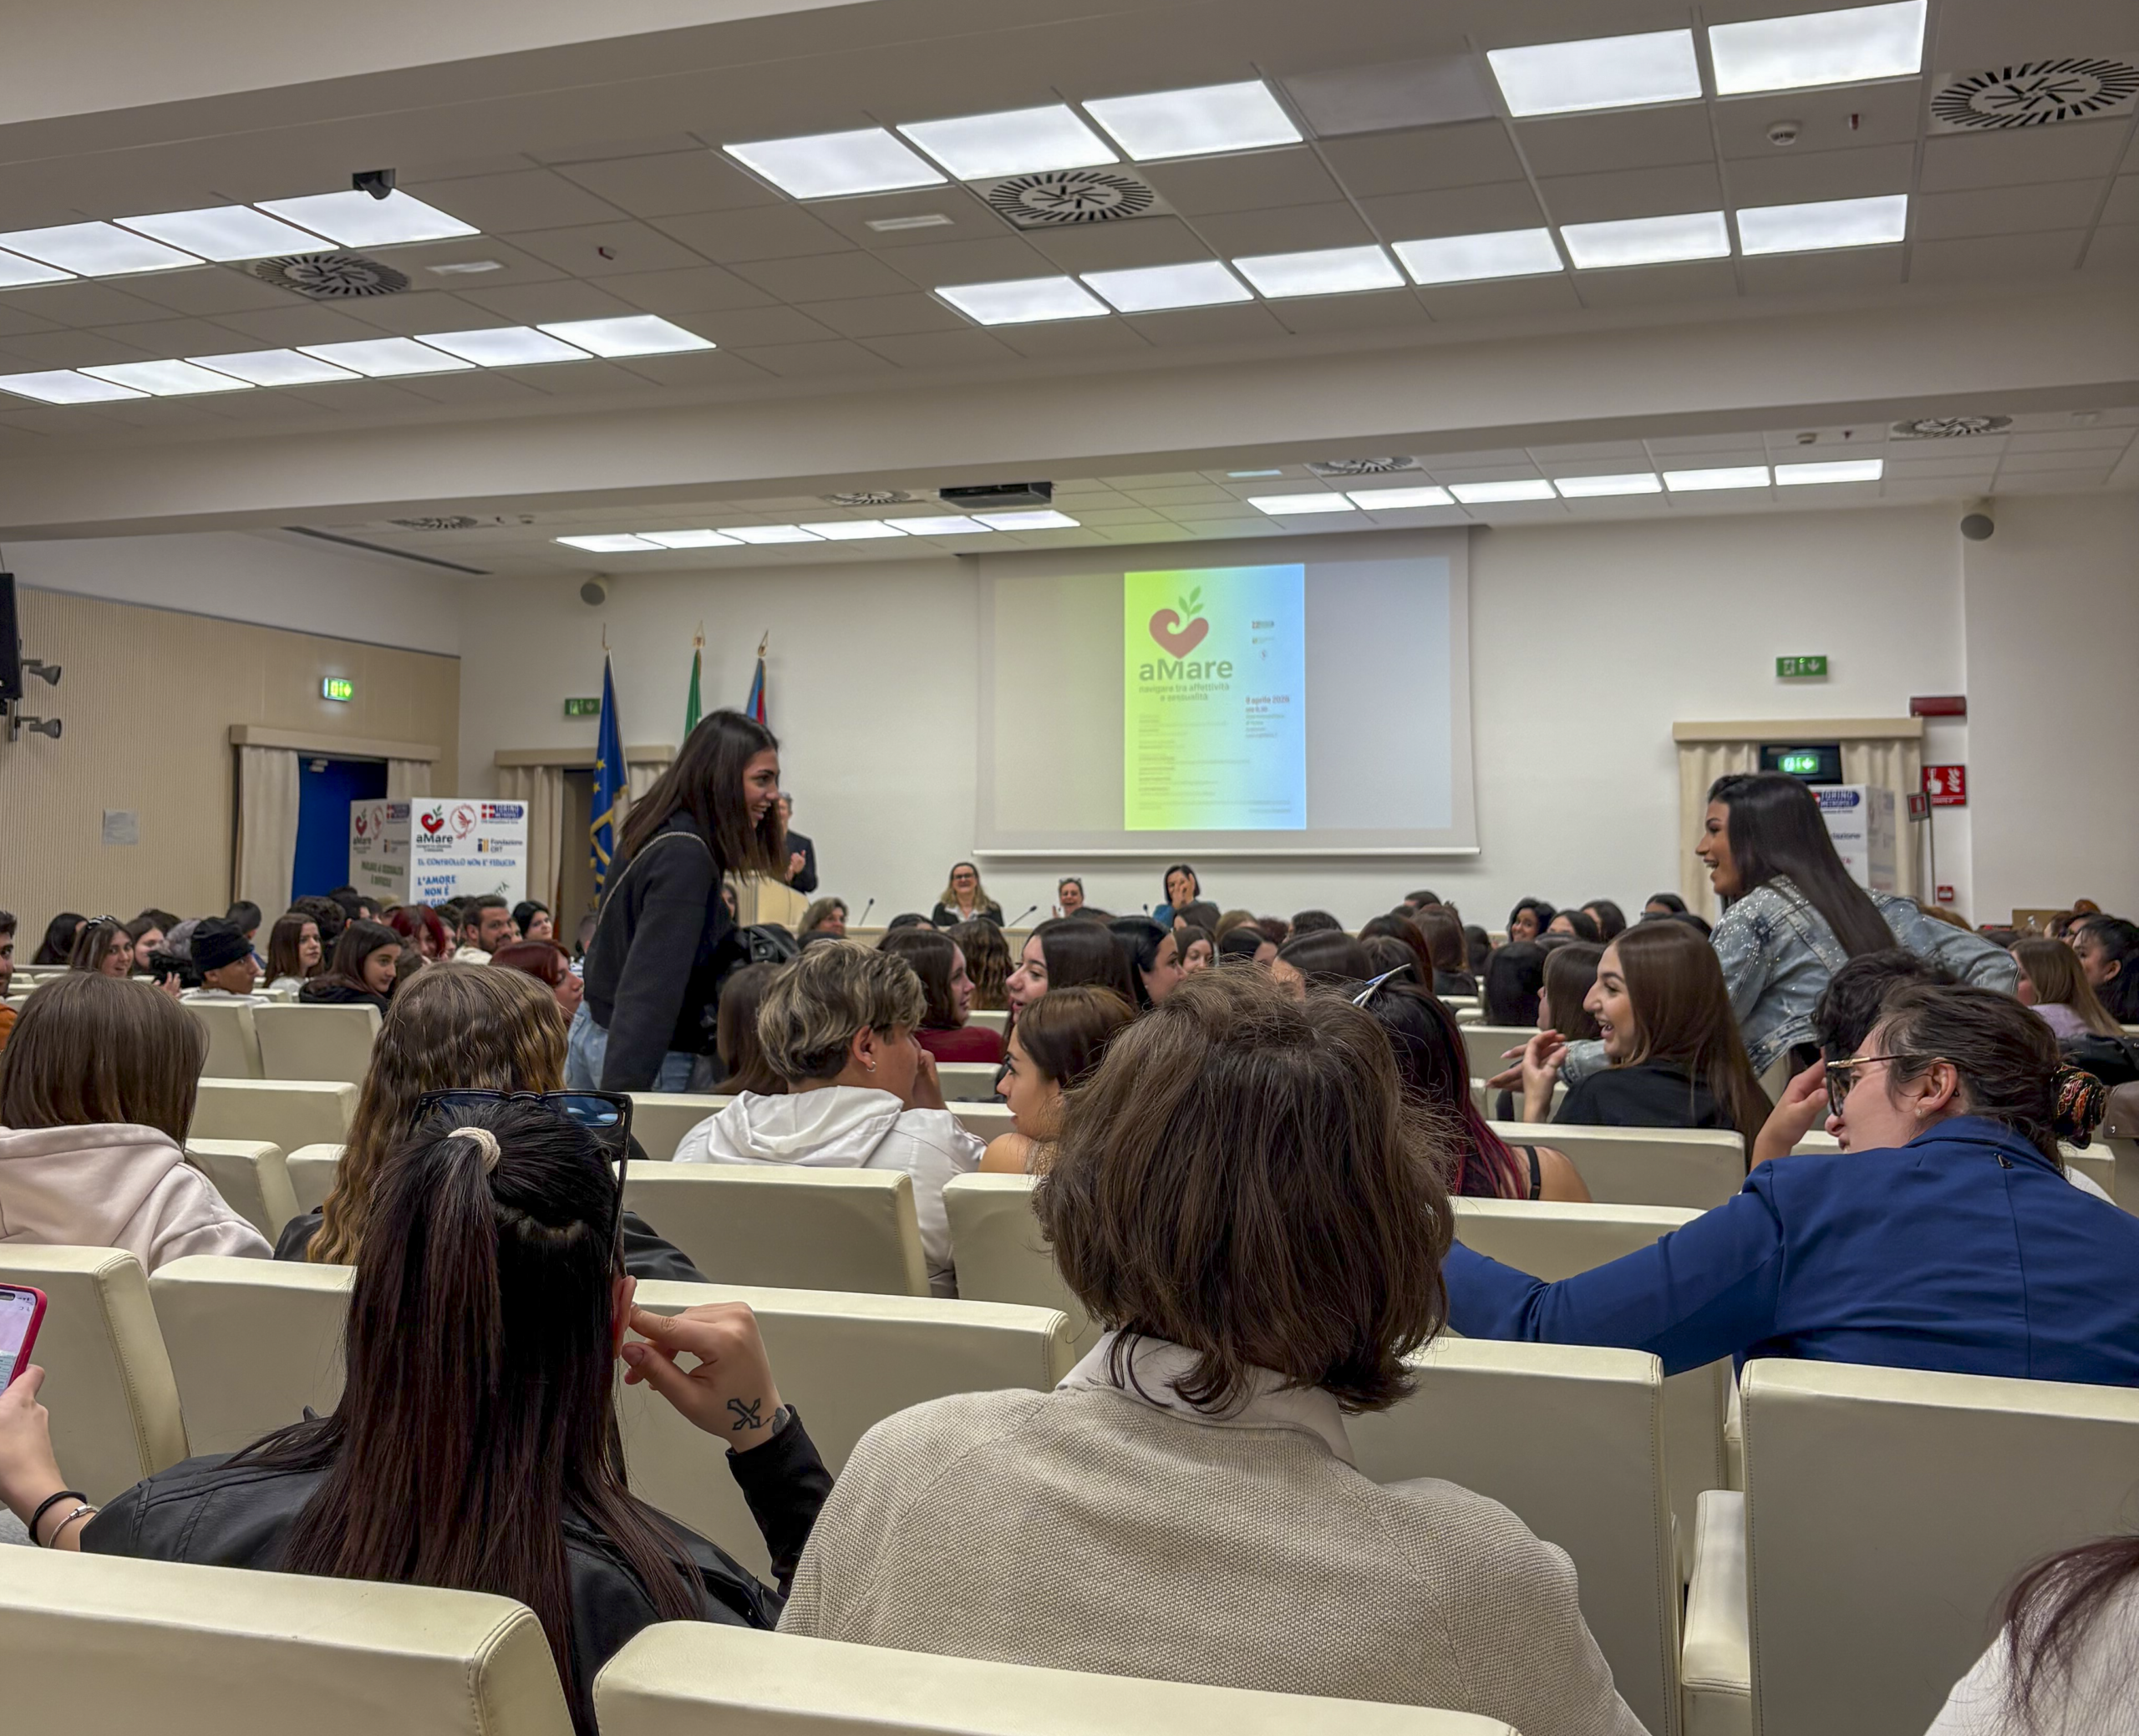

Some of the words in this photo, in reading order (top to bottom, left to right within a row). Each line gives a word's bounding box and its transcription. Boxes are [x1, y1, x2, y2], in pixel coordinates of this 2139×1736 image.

[1139, 658, 1233, 681] aMare
[1252, 695, 1271, 705] aprile
[1821, 790, 1853, 801] TORINO
[416, 834, 453, 844] aMare
[490, 838, 523, 846] Fondazione
[418, 858, 424, 866] IL
[427, 857, 465, 866] CONTROLLO
[467, 858, 480, 866] NON
[418, 875, 456, 886] L'AMORE
[424, 888, 441, 896] NON
[444, 885, 449, 896] È
